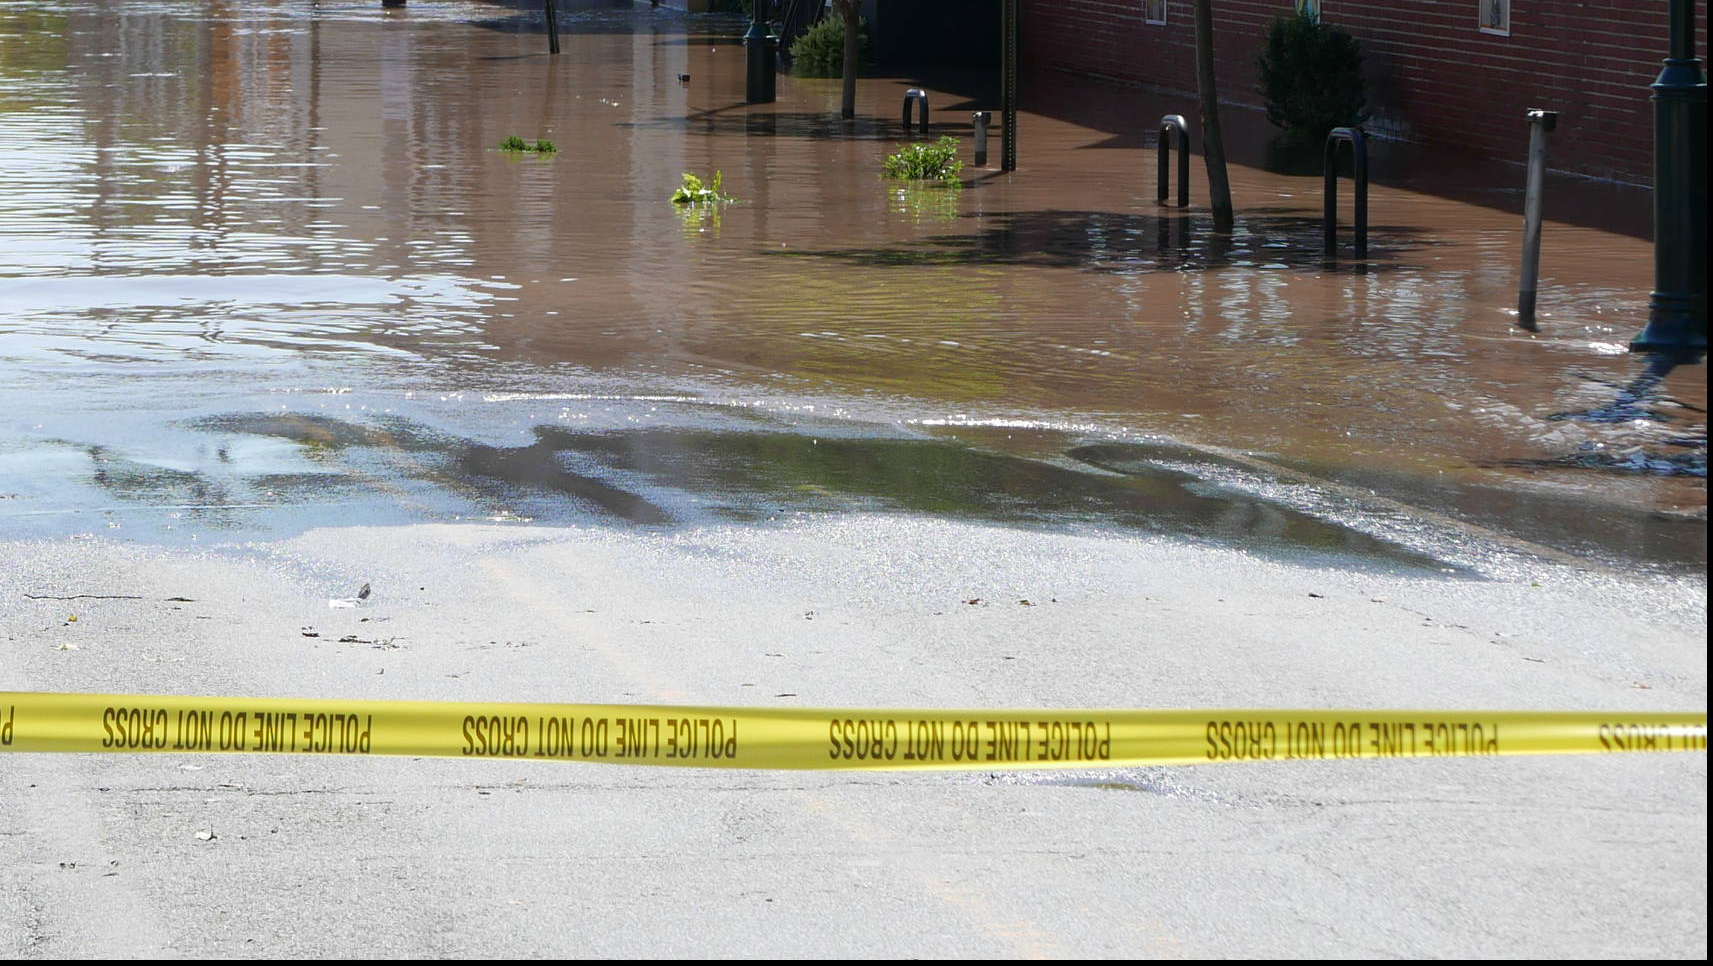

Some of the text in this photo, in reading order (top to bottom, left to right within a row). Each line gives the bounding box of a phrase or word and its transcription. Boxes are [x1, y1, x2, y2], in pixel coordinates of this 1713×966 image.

[103, 707, 372, 753] POLICE LINE DO NOT CROSS
[463, 716, 736, 758] POLICE LINE DO NOT CROSS
[830, 719, 1110, 761] POLICE LINE DO NOT CROSS
[1206, 721, 1498, 760] POLICE LINE DO NOT CROSS
[1599, 723, 1672, 752] CROSS
